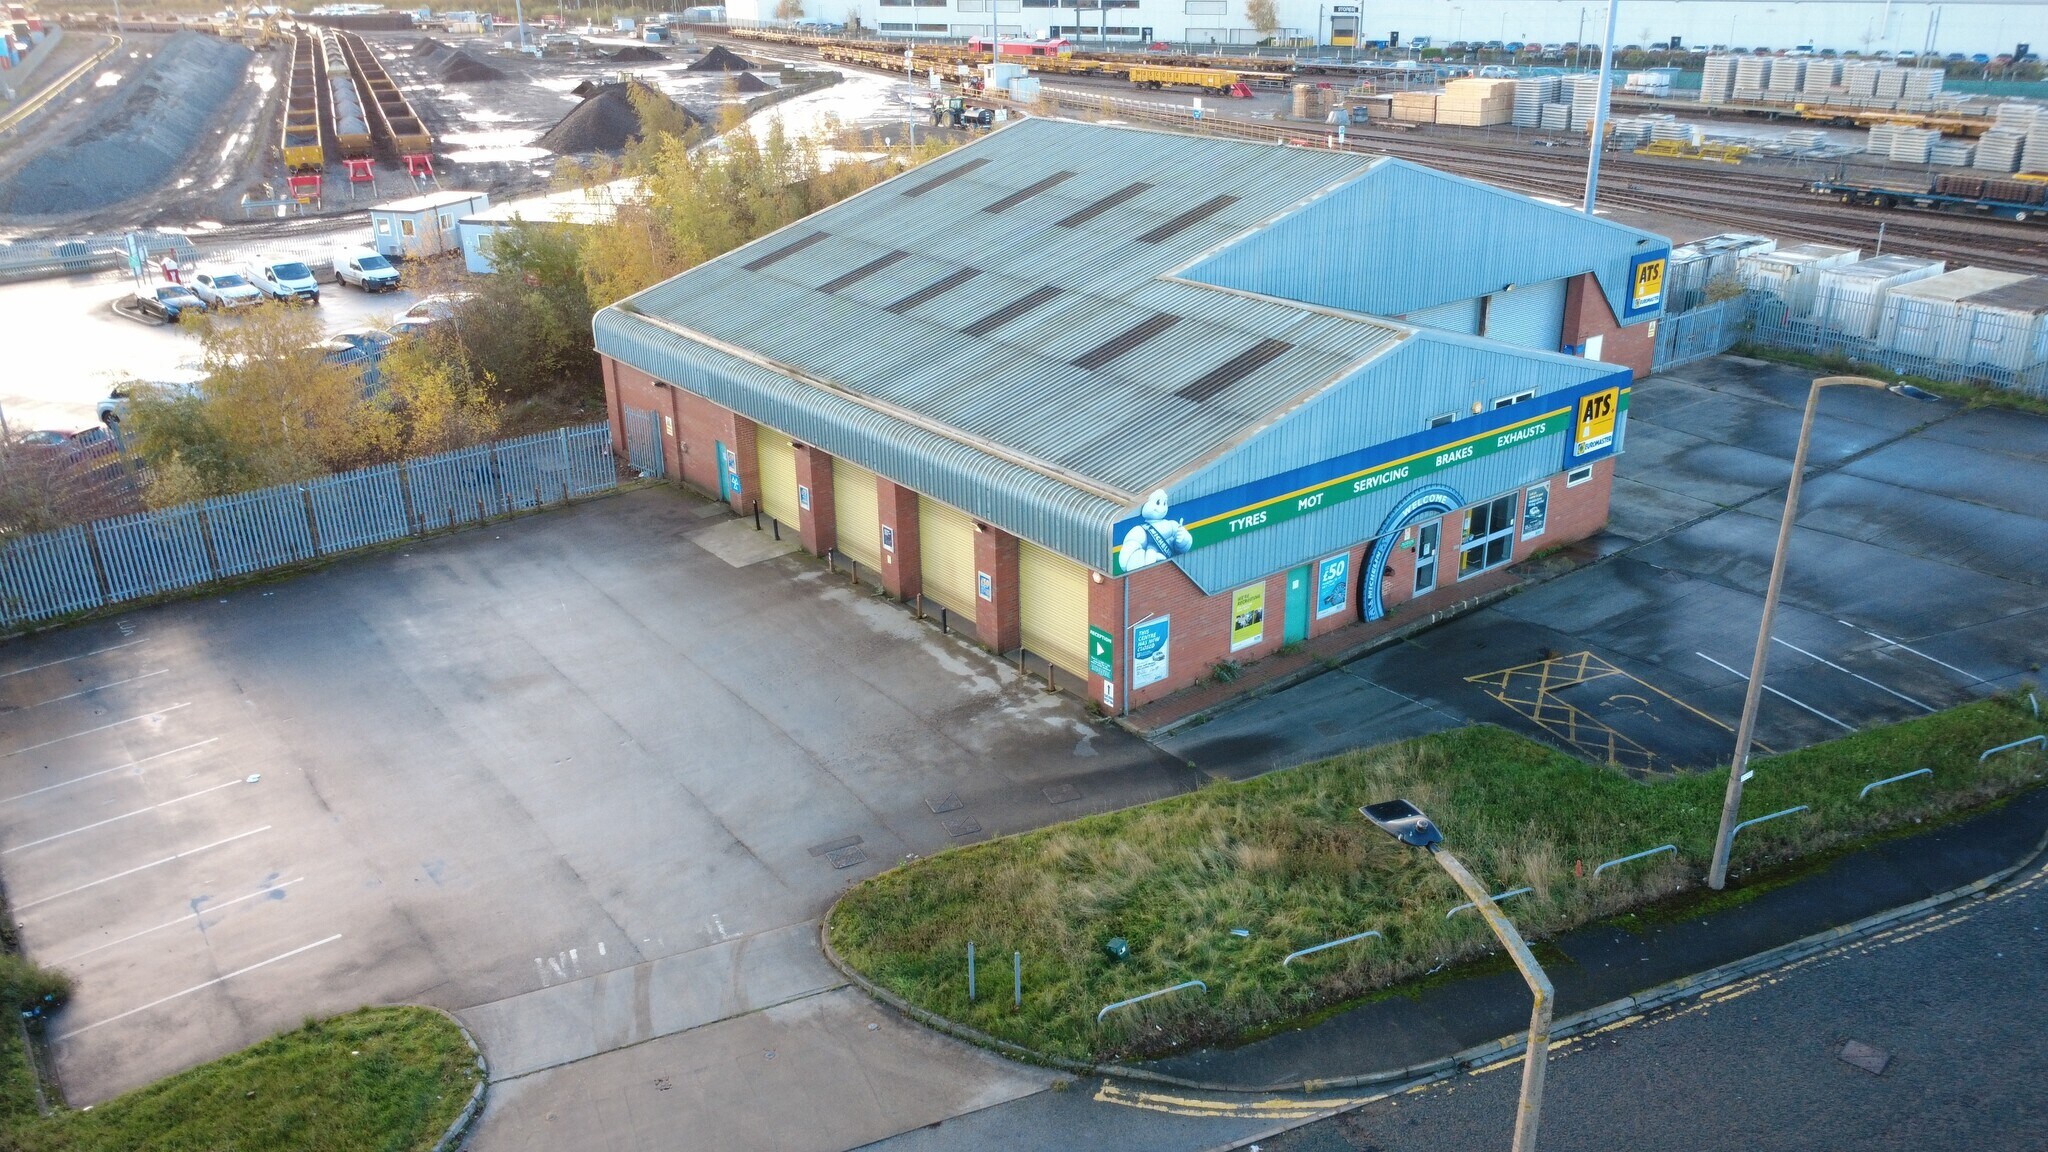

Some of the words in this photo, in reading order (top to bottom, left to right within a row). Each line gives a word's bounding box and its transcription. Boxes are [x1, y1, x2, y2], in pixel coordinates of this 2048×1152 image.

[1639, 263, 1660, 283] ATS
[1583, 393, 1612, 423] ATS
[1584, 435, 1612, 451] EUROMASTER
[1228, 510, 1268, 533] TYRES
[1297, 492, 1325, 512] MOT
[1353, 466, 1409, 494] SERVICING
[1435, 446, 1474, 467] BRAKES
[1497, 422, 1547, 448] EXHAUSTS
[1401, 494, 1448, 517] WELCOME
[1322, 560, 1345, 582] £50
[1368, 551, 1382, 599] MICHELIN
[1089, 629, 1112, 644] RECEPTION
